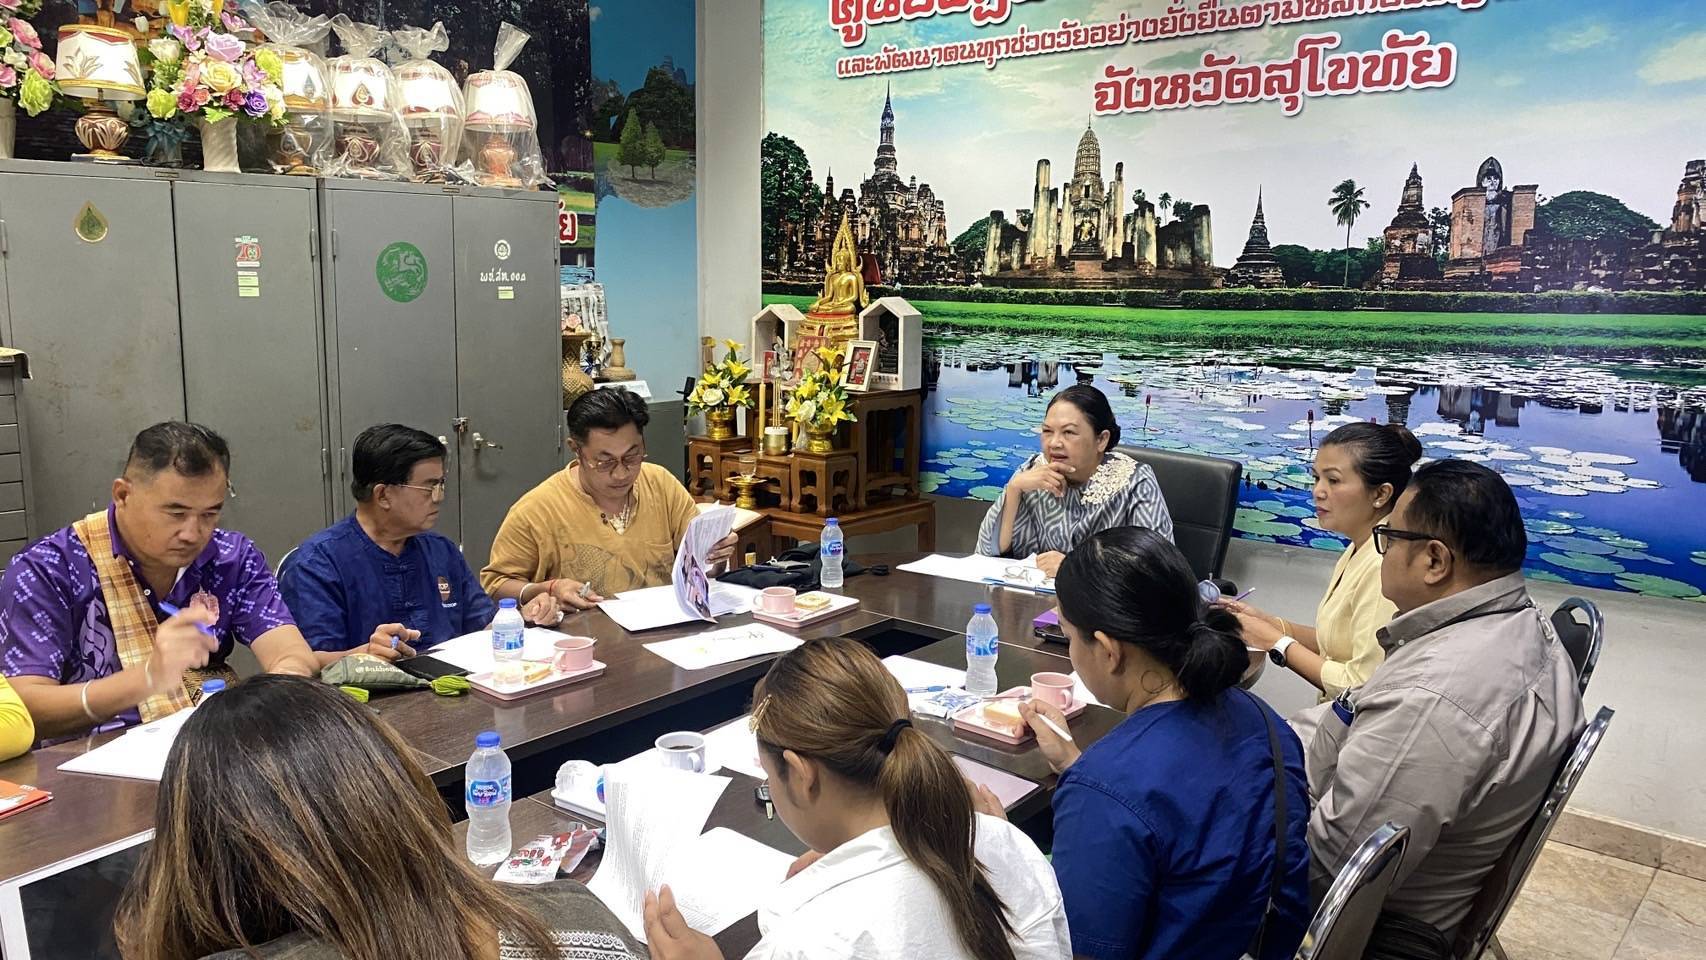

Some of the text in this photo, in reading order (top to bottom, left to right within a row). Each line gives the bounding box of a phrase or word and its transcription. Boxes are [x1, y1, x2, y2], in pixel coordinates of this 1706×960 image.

[1094, 33, 1452, 112] จังหวัดสุโขทัย
